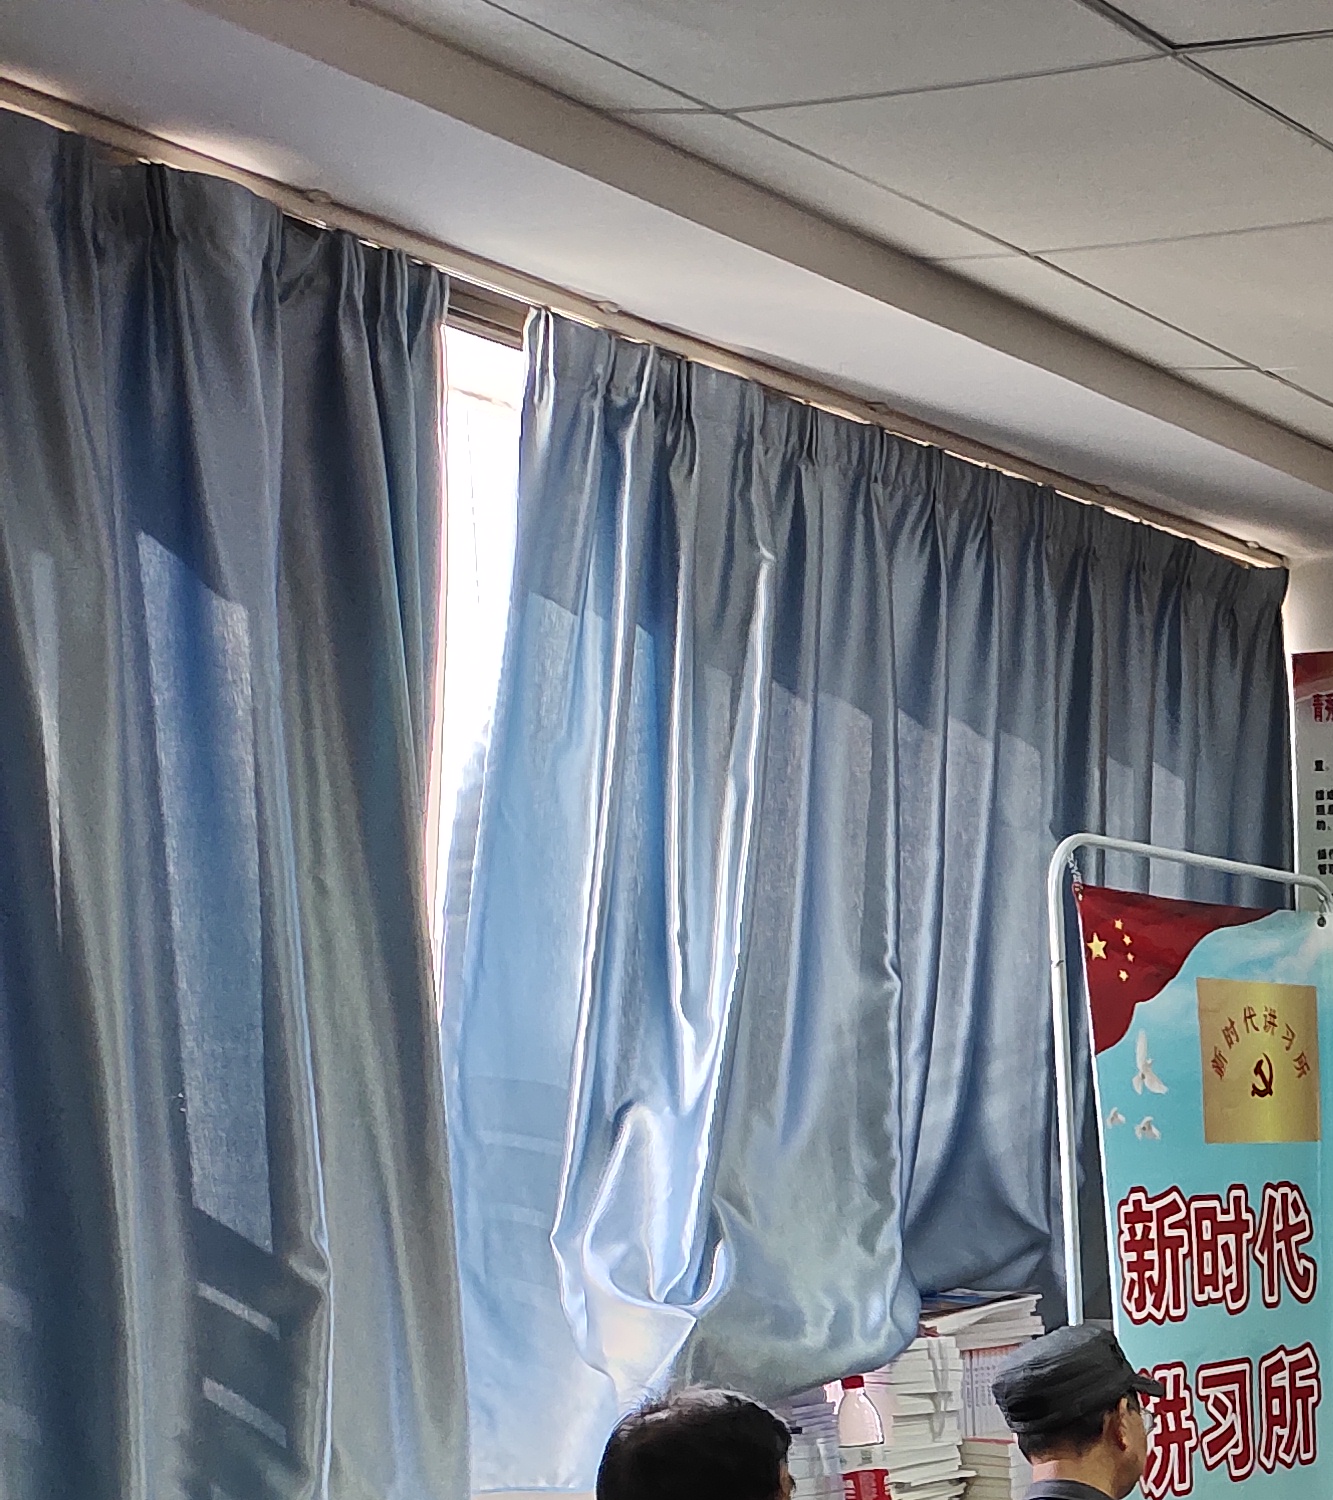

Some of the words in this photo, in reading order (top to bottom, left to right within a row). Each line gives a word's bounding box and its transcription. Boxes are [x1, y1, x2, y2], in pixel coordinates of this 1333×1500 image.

[1211, 1005, 1311, 1080] 新时代讲习所
[1117, 1182, 1317, 1325] 新时代
